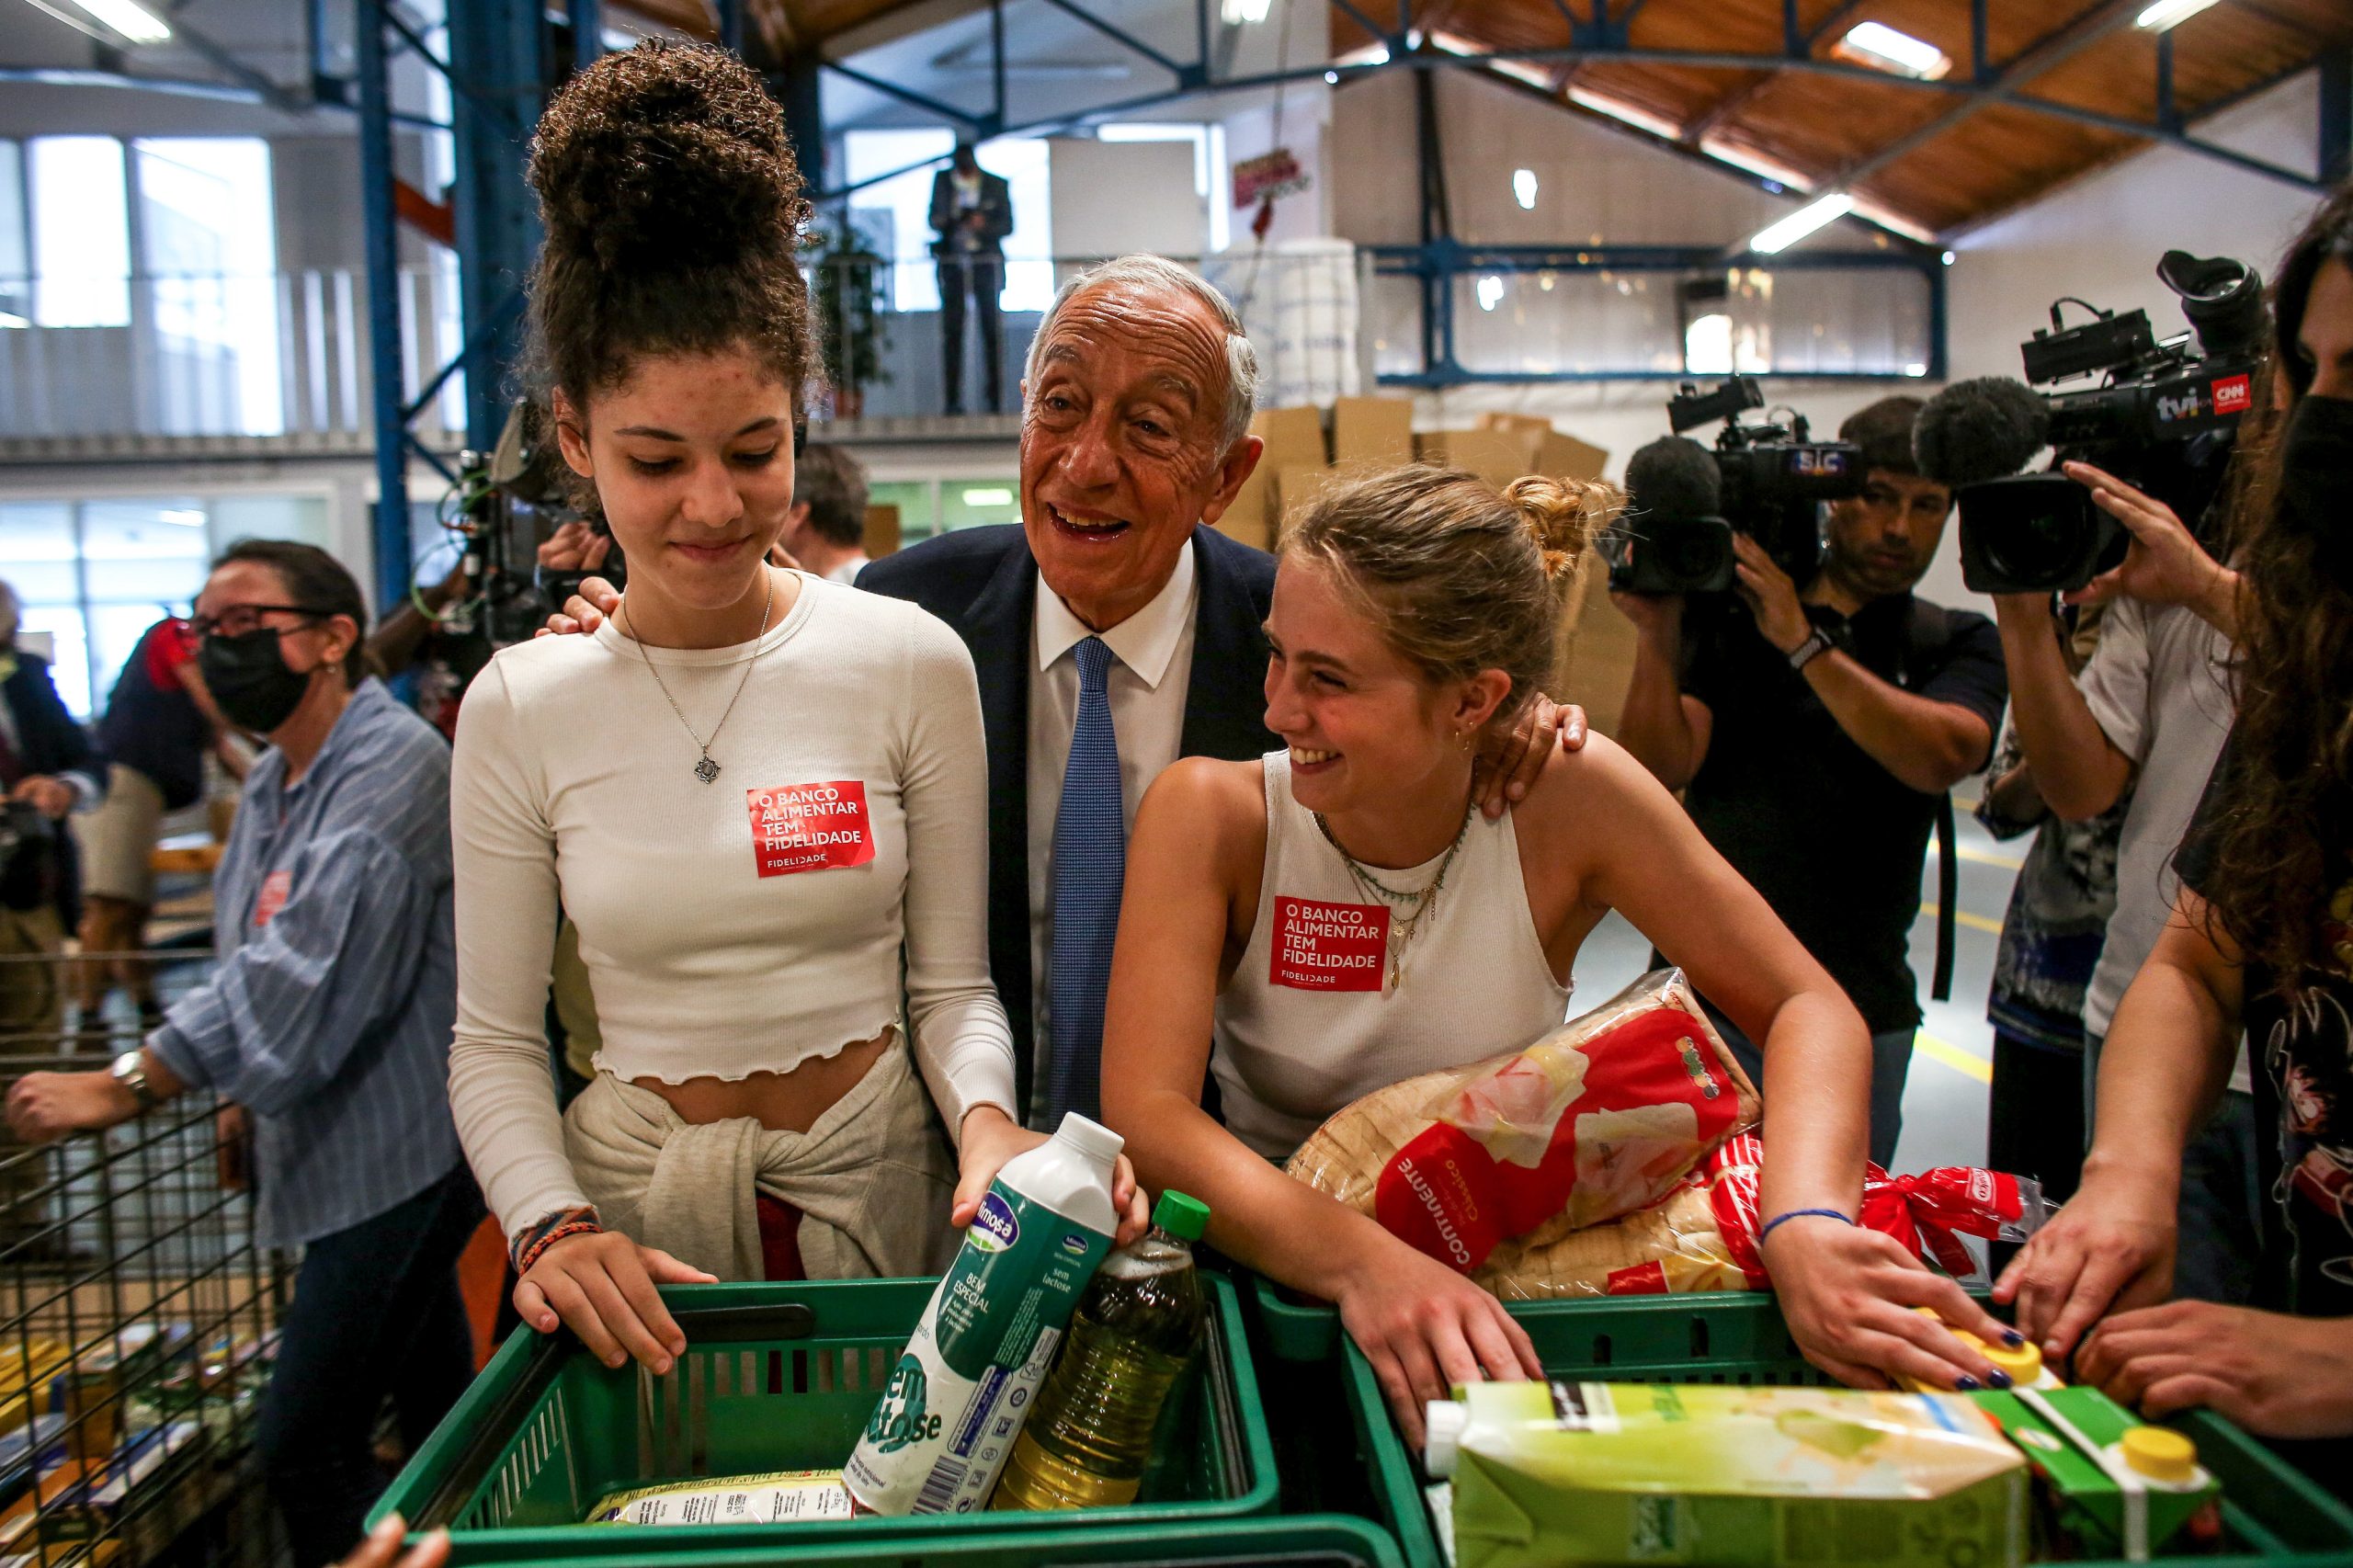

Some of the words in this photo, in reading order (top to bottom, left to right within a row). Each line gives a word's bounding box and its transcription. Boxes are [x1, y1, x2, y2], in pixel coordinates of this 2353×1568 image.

[2217, 383, 2245, 401] CNN
[2156, 387, 2199, 422] tvi
[759, 795, 772, 807] O
[778, 788, 838, 805] BANCO
[761, 801, 858, 822] ALIMENTAR
[762, 822, 799, 835] TEM
[765, 831, 861, 851] FIDELIDADE
[767, 854, 826, 868] FIDELIDADE
[1287, 904, 1298, 917] O
[1302, 906, 1363, 924] BANCO
[1284, 919, 1379, 938] ALIMENTAR
[1284, 934, 1315, 950] TEM
[1282, 949, 1376, 968] FIDELIDADE
[1281, 970, 1336, 983] FIDELIDADE
[1398, 1158, 1470, 1265] CONTINENTE
[966, 1272, 986, 1293] BEM
[1042, 1272, 1071, 1292] lactose
[1053, 1267, 1069, 1280] sem
[953, 1279, 989, 1314] ESPECIAL
